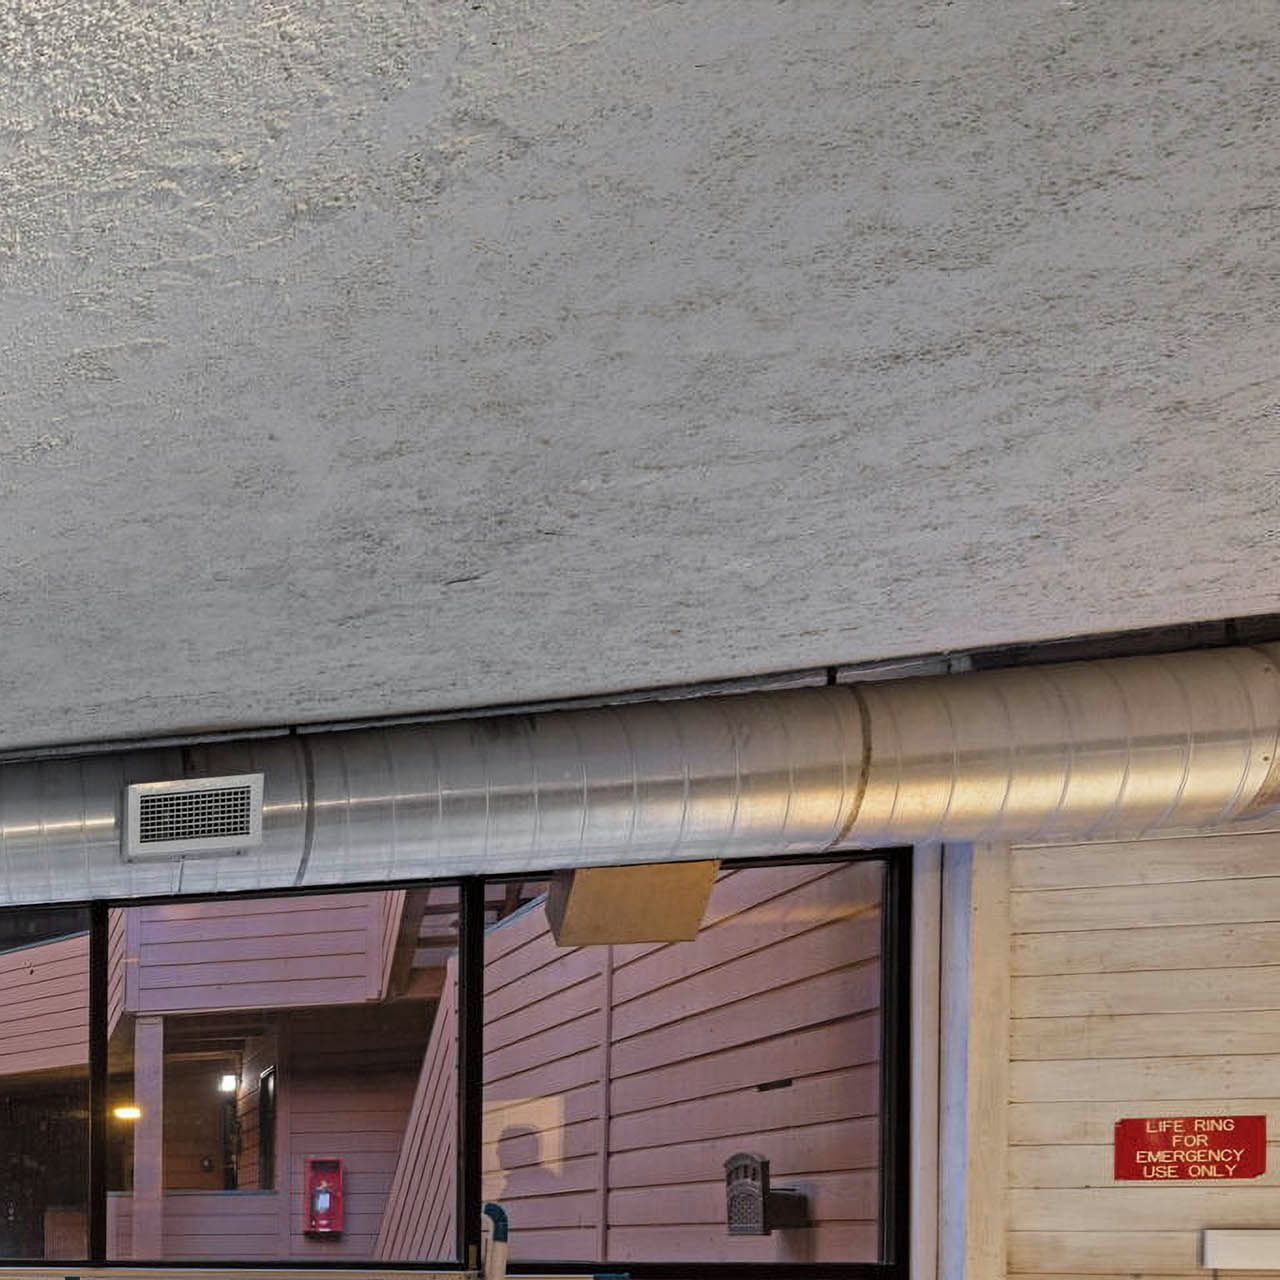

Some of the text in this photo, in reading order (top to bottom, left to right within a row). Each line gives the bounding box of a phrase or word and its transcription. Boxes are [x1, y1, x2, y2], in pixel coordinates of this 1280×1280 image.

[1145, 1119, 1235, 1133] LIFE RING
[1172, 1134, 1208, 1147] FOR
[1136, 1149, 1245, 1163] EMERGENCY
[1143, 1164, 1237, 1178] USE ONLY
